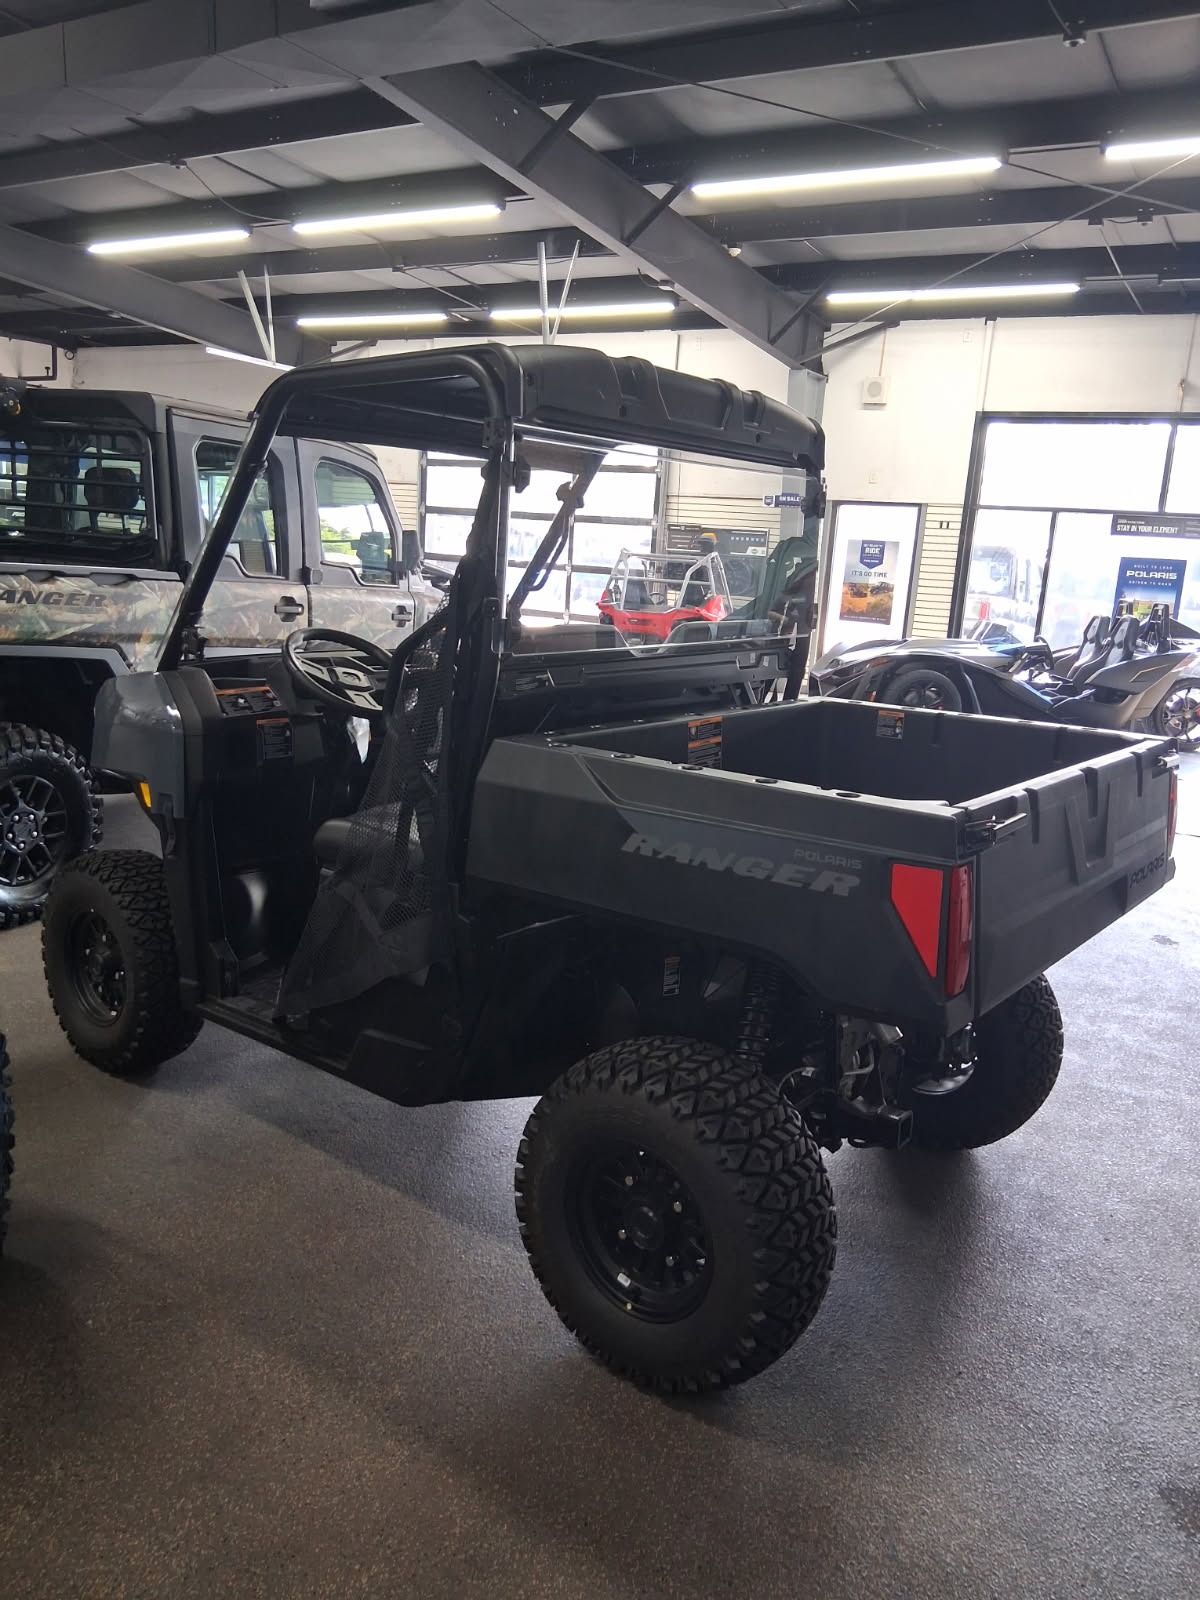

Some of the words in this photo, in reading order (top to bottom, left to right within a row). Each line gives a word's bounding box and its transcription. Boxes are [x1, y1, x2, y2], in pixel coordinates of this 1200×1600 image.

[1116, 524, 1130, 532] STAY
[1130, 524, 1137, 532] IN
[1138, 525, 1152, 533] YOUR
[1152, 526, 1178, 534] ELEMENT
[1126, 570, 1177, 580] POLARIS
[620, 833, 861, 896] RANGER
[794, 848, 863, 870] POLARIS
[1129, 852, 1165, 888] POLARIS
